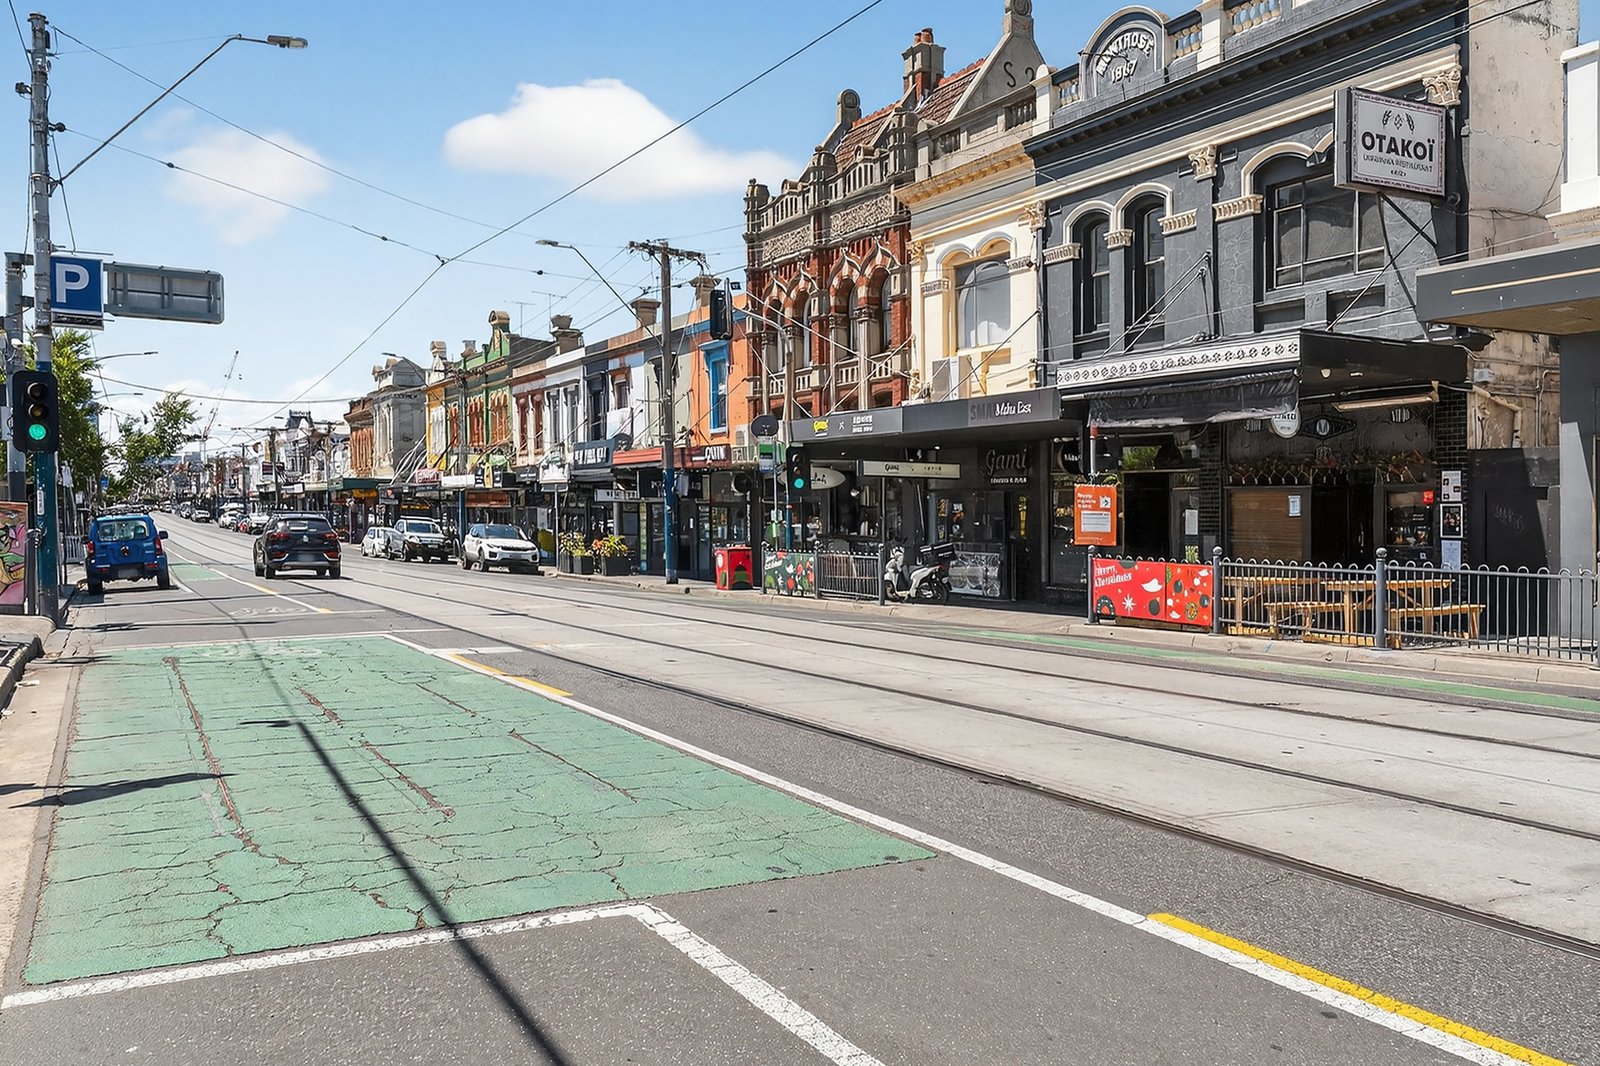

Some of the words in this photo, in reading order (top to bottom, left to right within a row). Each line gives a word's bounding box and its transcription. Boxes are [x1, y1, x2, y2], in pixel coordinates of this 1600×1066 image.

[1361, 131, 1435, 162] OTAKOÏ
[55, 262, 90, 303] P
[986, 447, 1028, 475] Gami
